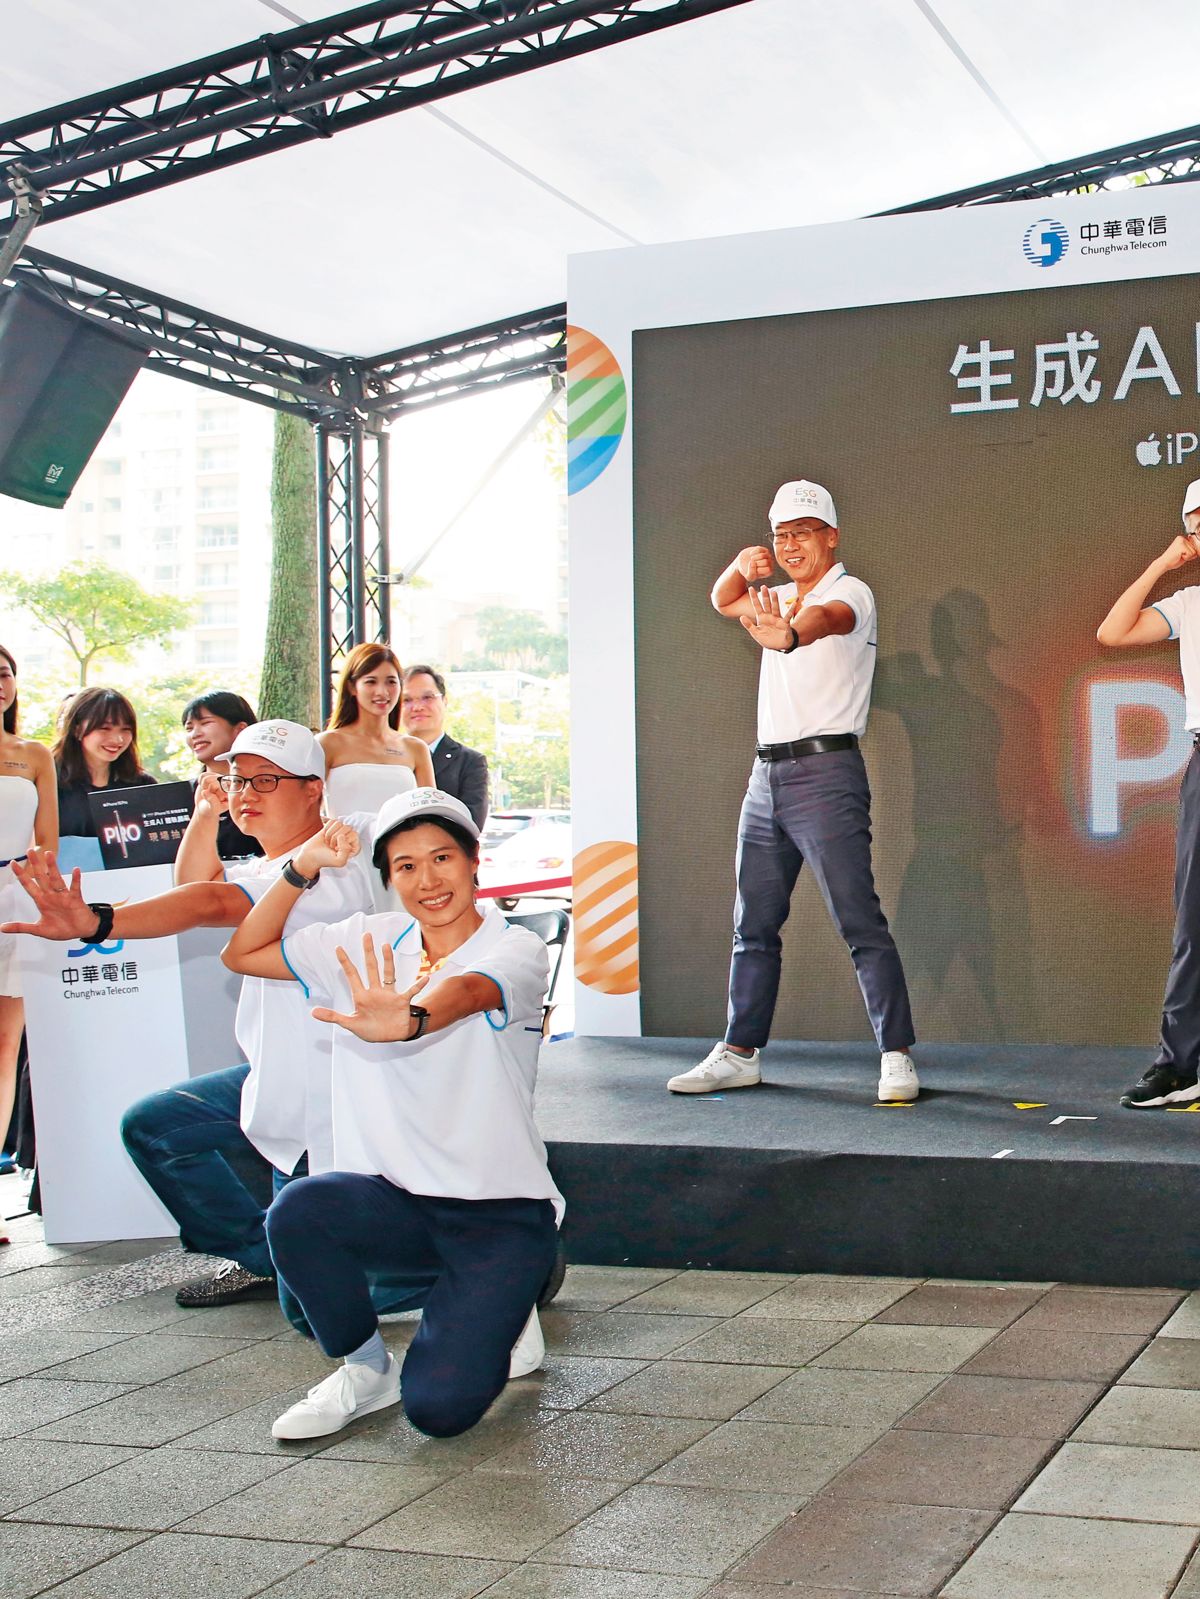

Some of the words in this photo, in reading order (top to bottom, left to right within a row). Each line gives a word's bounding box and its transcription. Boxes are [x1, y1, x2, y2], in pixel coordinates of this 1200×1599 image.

[1080, 214, 1167, 241] 中華電信
[1080, 242, 1129, 258] Chunghwa
[1129, 238, 1168, 251] Telecom
[795, 487, 817, 498] ESG
[148, 829, 187, 842] 現場抽
[61, 961, 138, 985] 中華電信
[63, 989, 106, 1000] Chunghwa
[107, 985, 139, 996] Telecom
